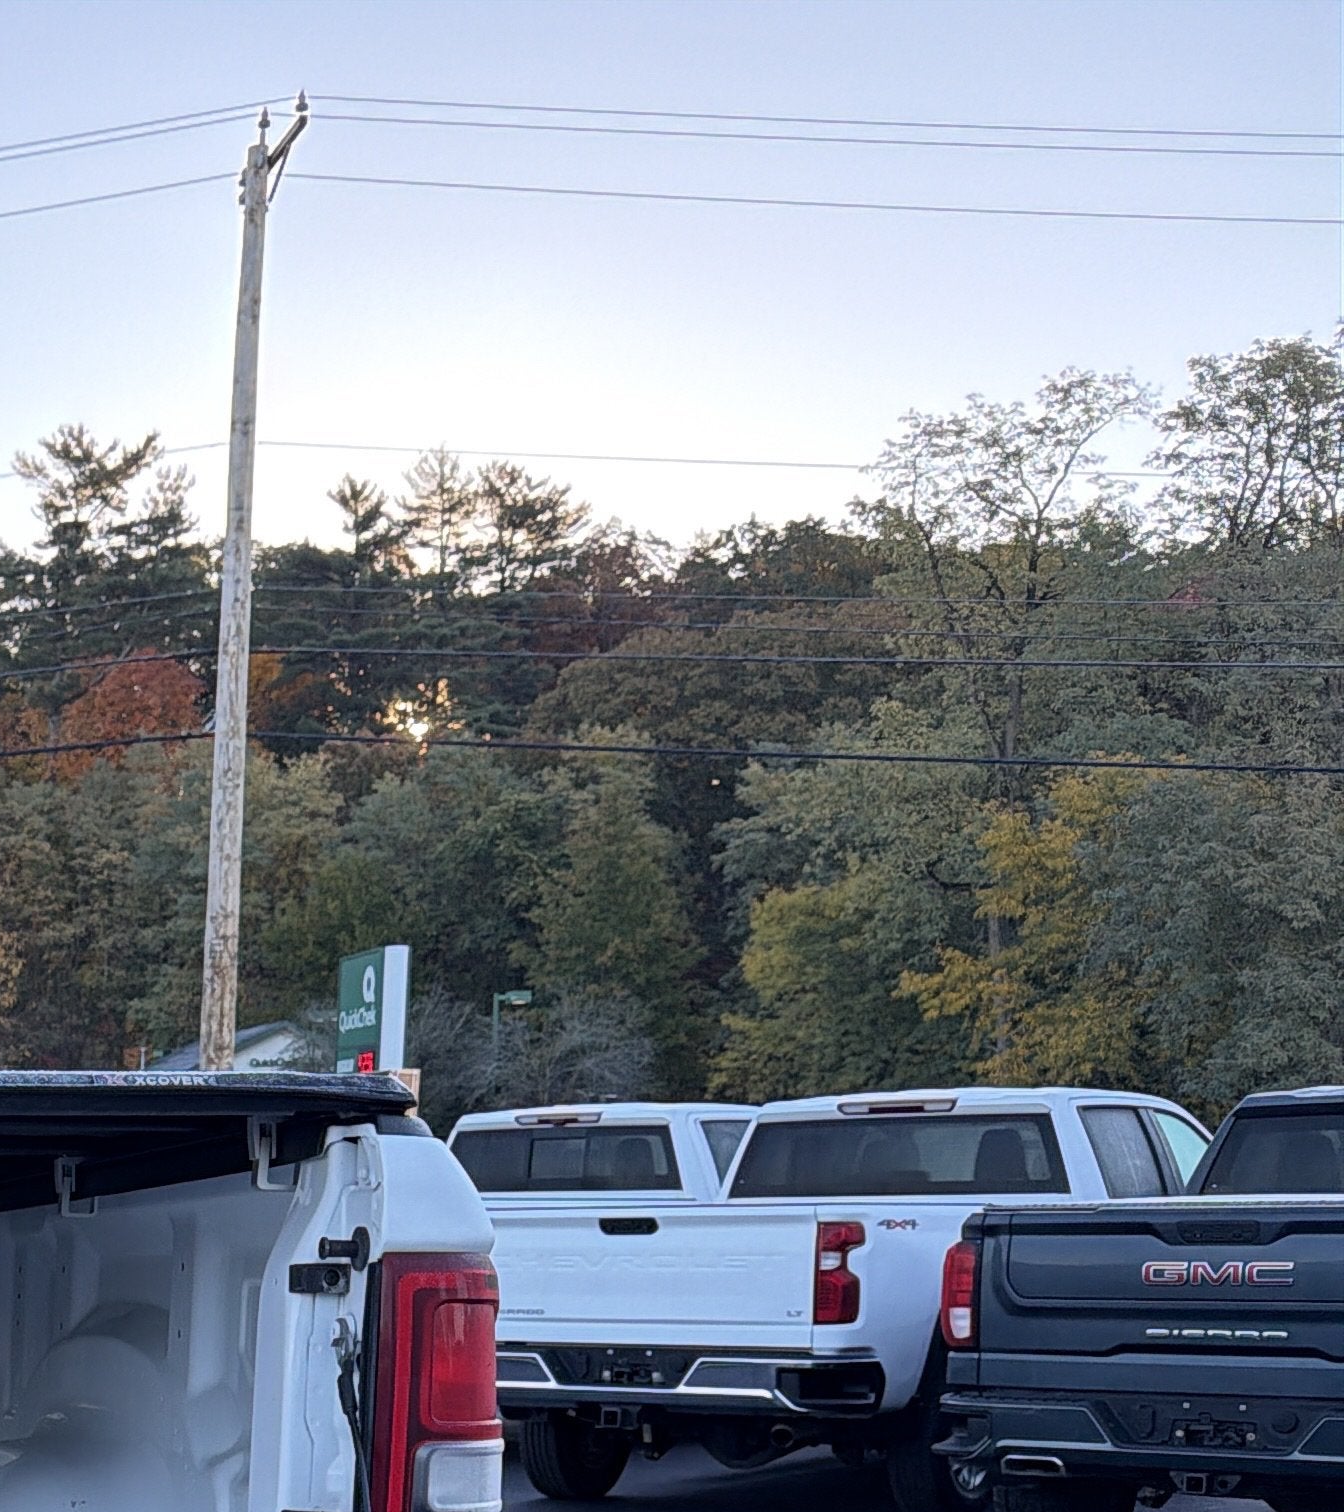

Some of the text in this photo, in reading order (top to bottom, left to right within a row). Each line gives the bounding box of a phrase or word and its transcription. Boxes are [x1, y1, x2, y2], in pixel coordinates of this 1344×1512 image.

[134, 1074, 205, 1086] XCOVER
[1141, 1261, 1295, 1286] GMC
[1145, 1328, 1288, 1340] SIERRA
